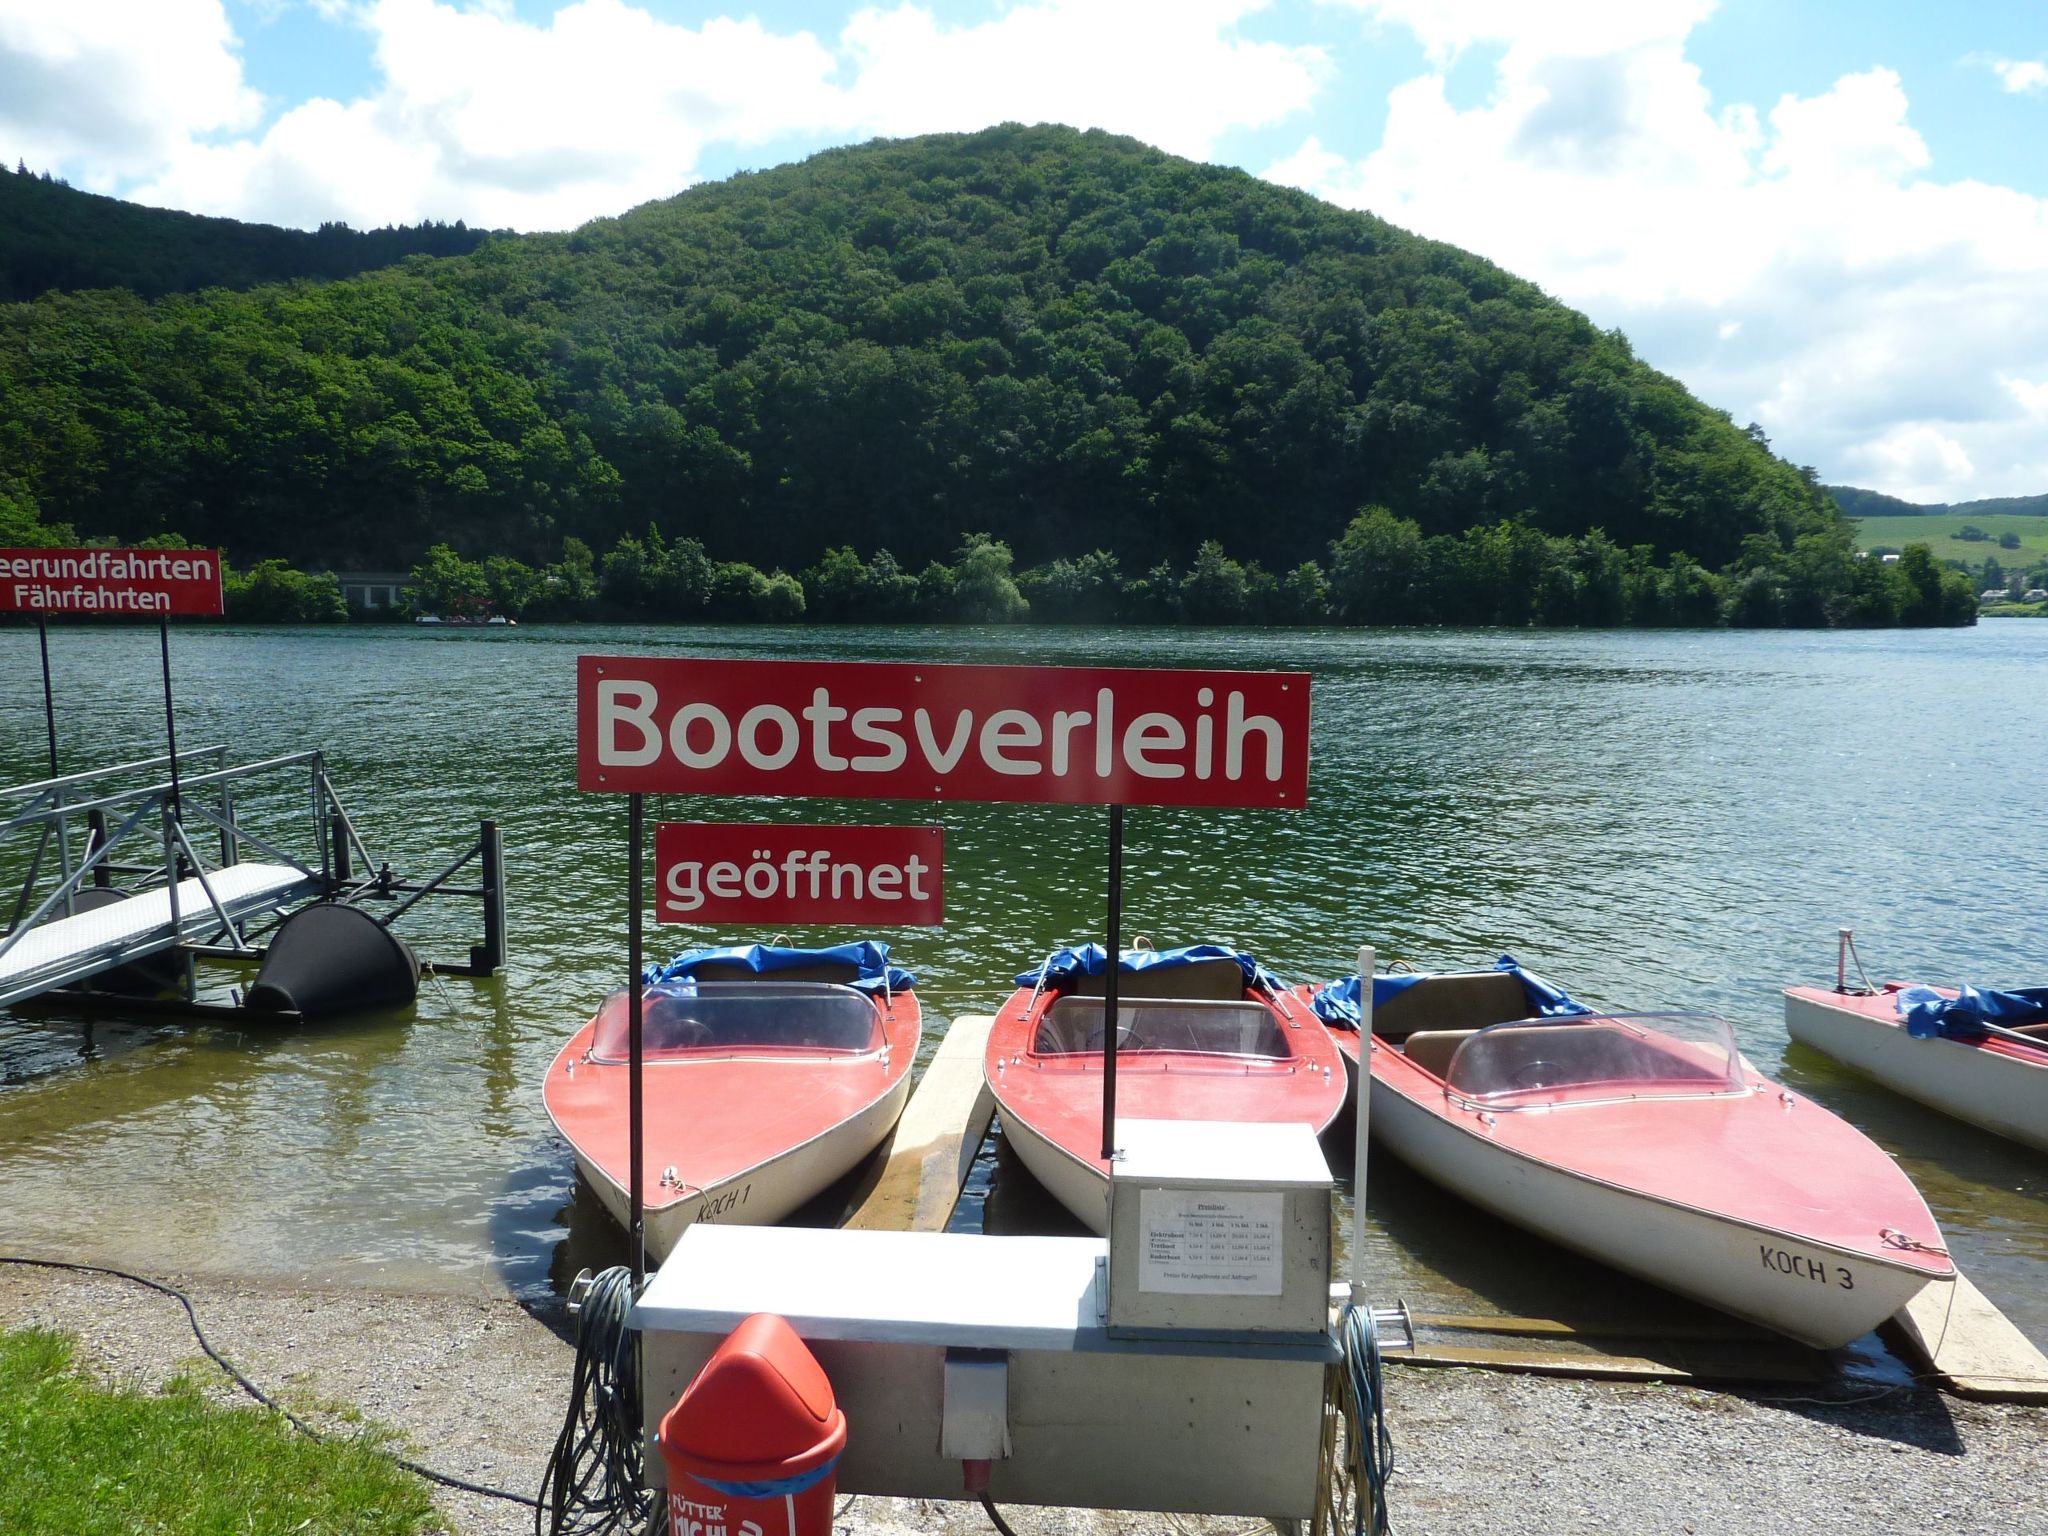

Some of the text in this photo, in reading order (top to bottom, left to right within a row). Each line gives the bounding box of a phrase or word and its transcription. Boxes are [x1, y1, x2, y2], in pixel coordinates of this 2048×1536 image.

[14, 584, 171, 610] Fährfahrten
[596, 678, 1284, 783] Bootsverleih
[666, 849, 930, 911] geöffnet
[696, 1183, 752, 1223] KOCH 1
[1759, 1245, 1854, 1290] KOCH 3
